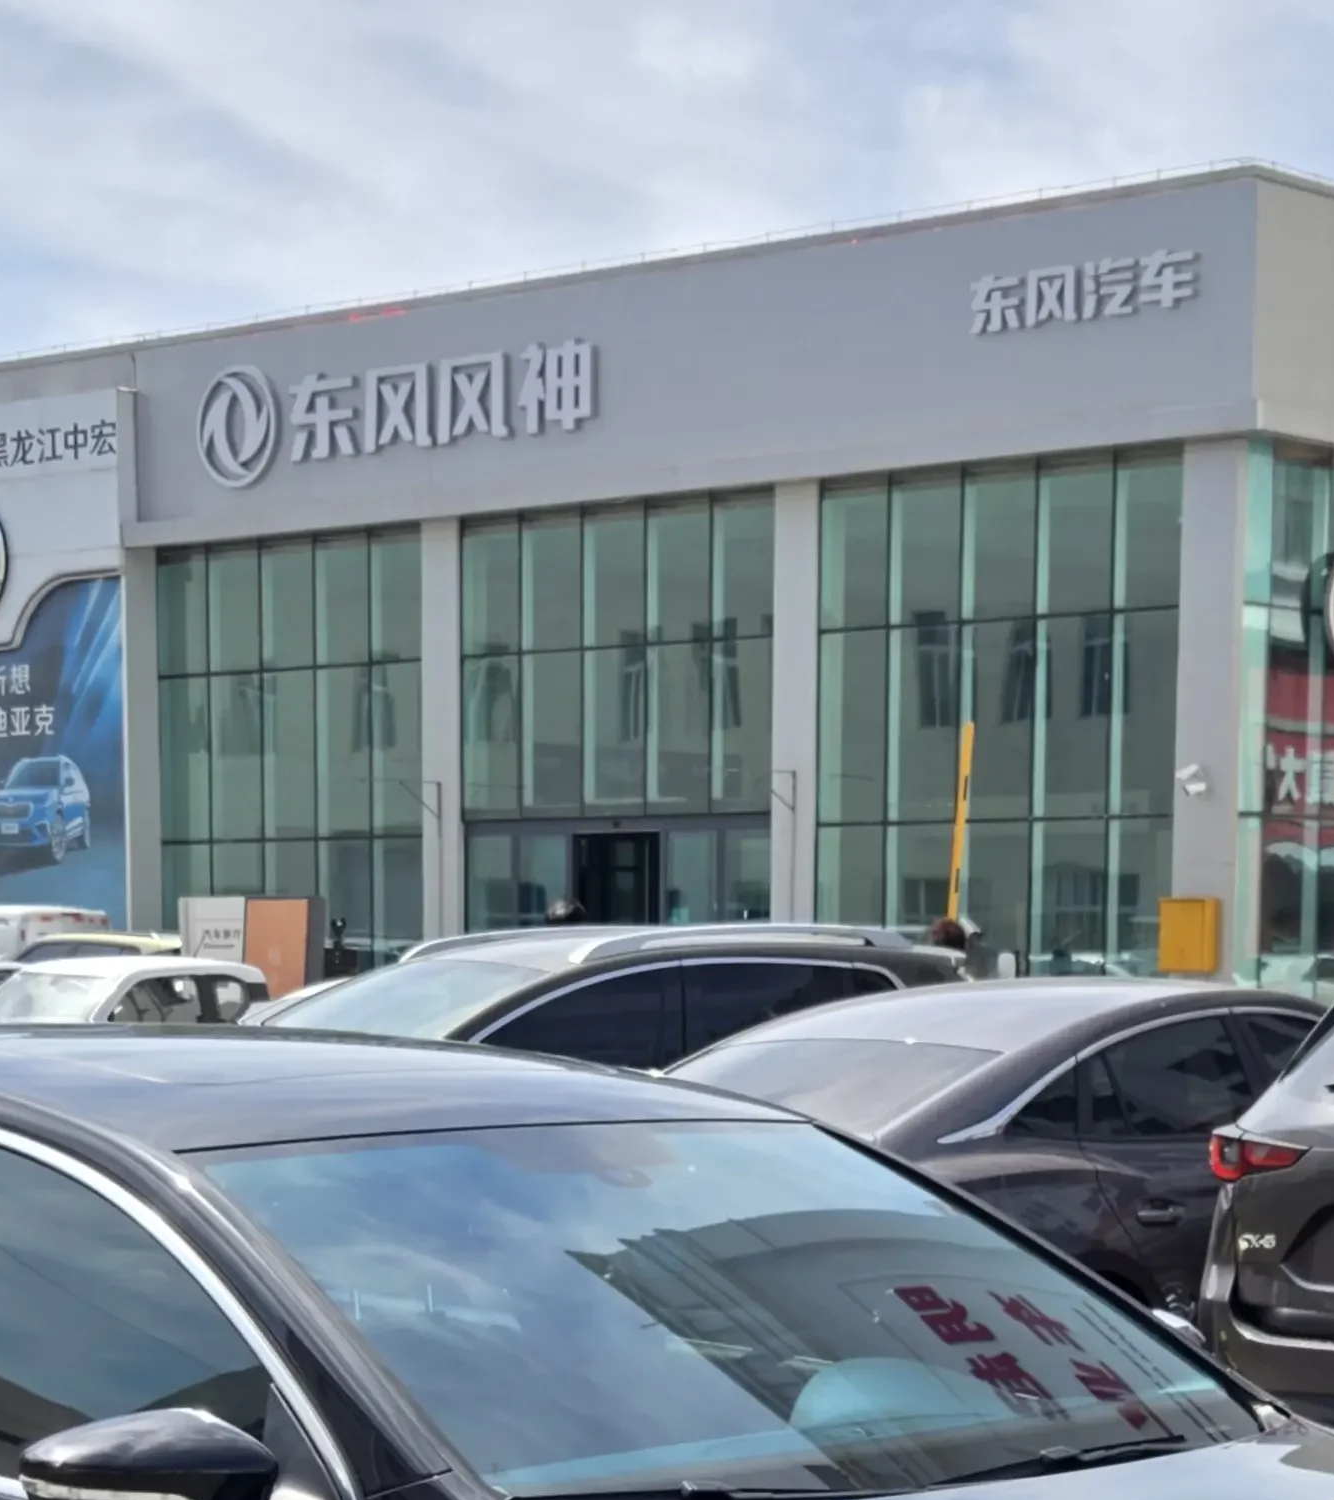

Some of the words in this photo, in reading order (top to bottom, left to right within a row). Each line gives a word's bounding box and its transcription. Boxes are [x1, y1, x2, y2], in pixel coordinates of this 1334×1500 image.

[969, 249, 1195, 334] 东风汽车
[288, 337, 595, 463] 东风风神
